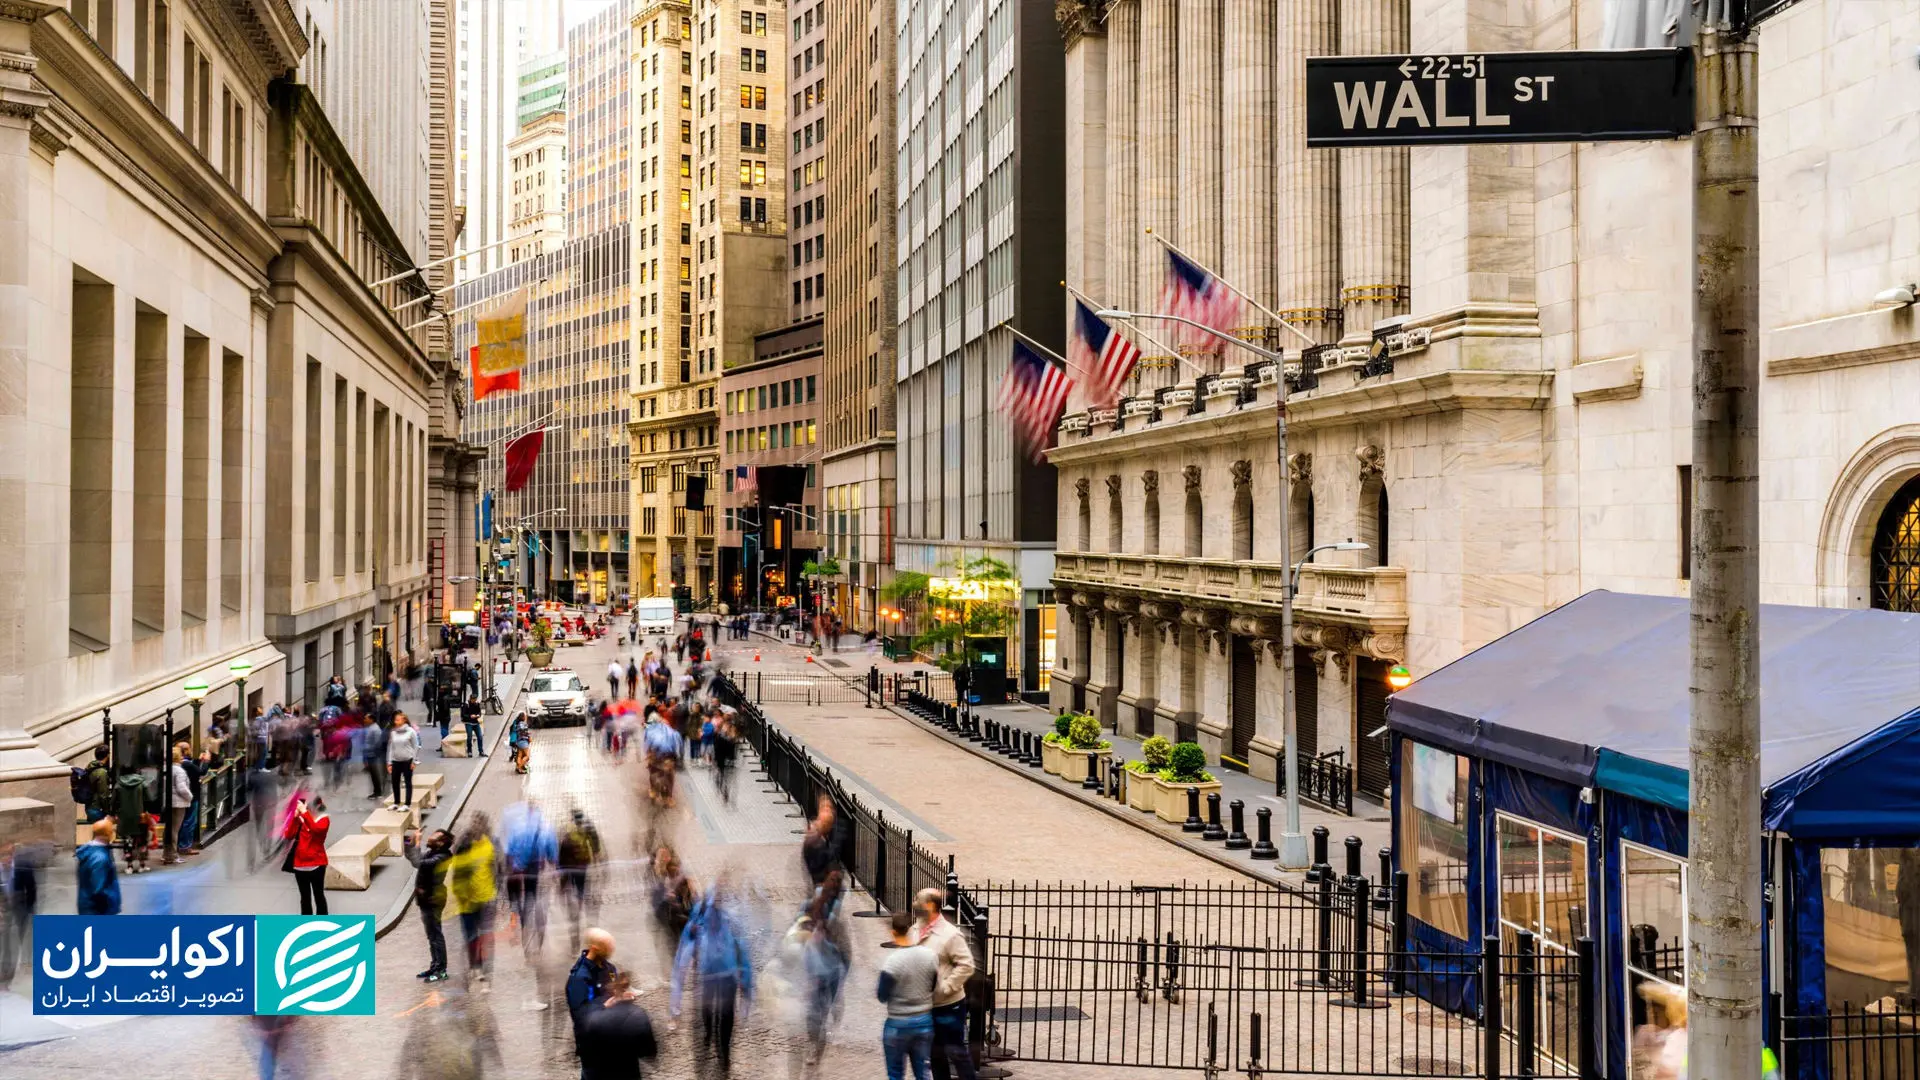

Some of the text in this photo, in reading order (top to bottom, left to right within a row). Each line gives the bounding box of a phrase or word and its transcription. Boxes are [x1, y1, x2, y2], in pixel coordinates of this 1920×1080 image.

[1421, 55, 1486, 79] 22-51
[1333, 75, 1555, 130] WALL ST
